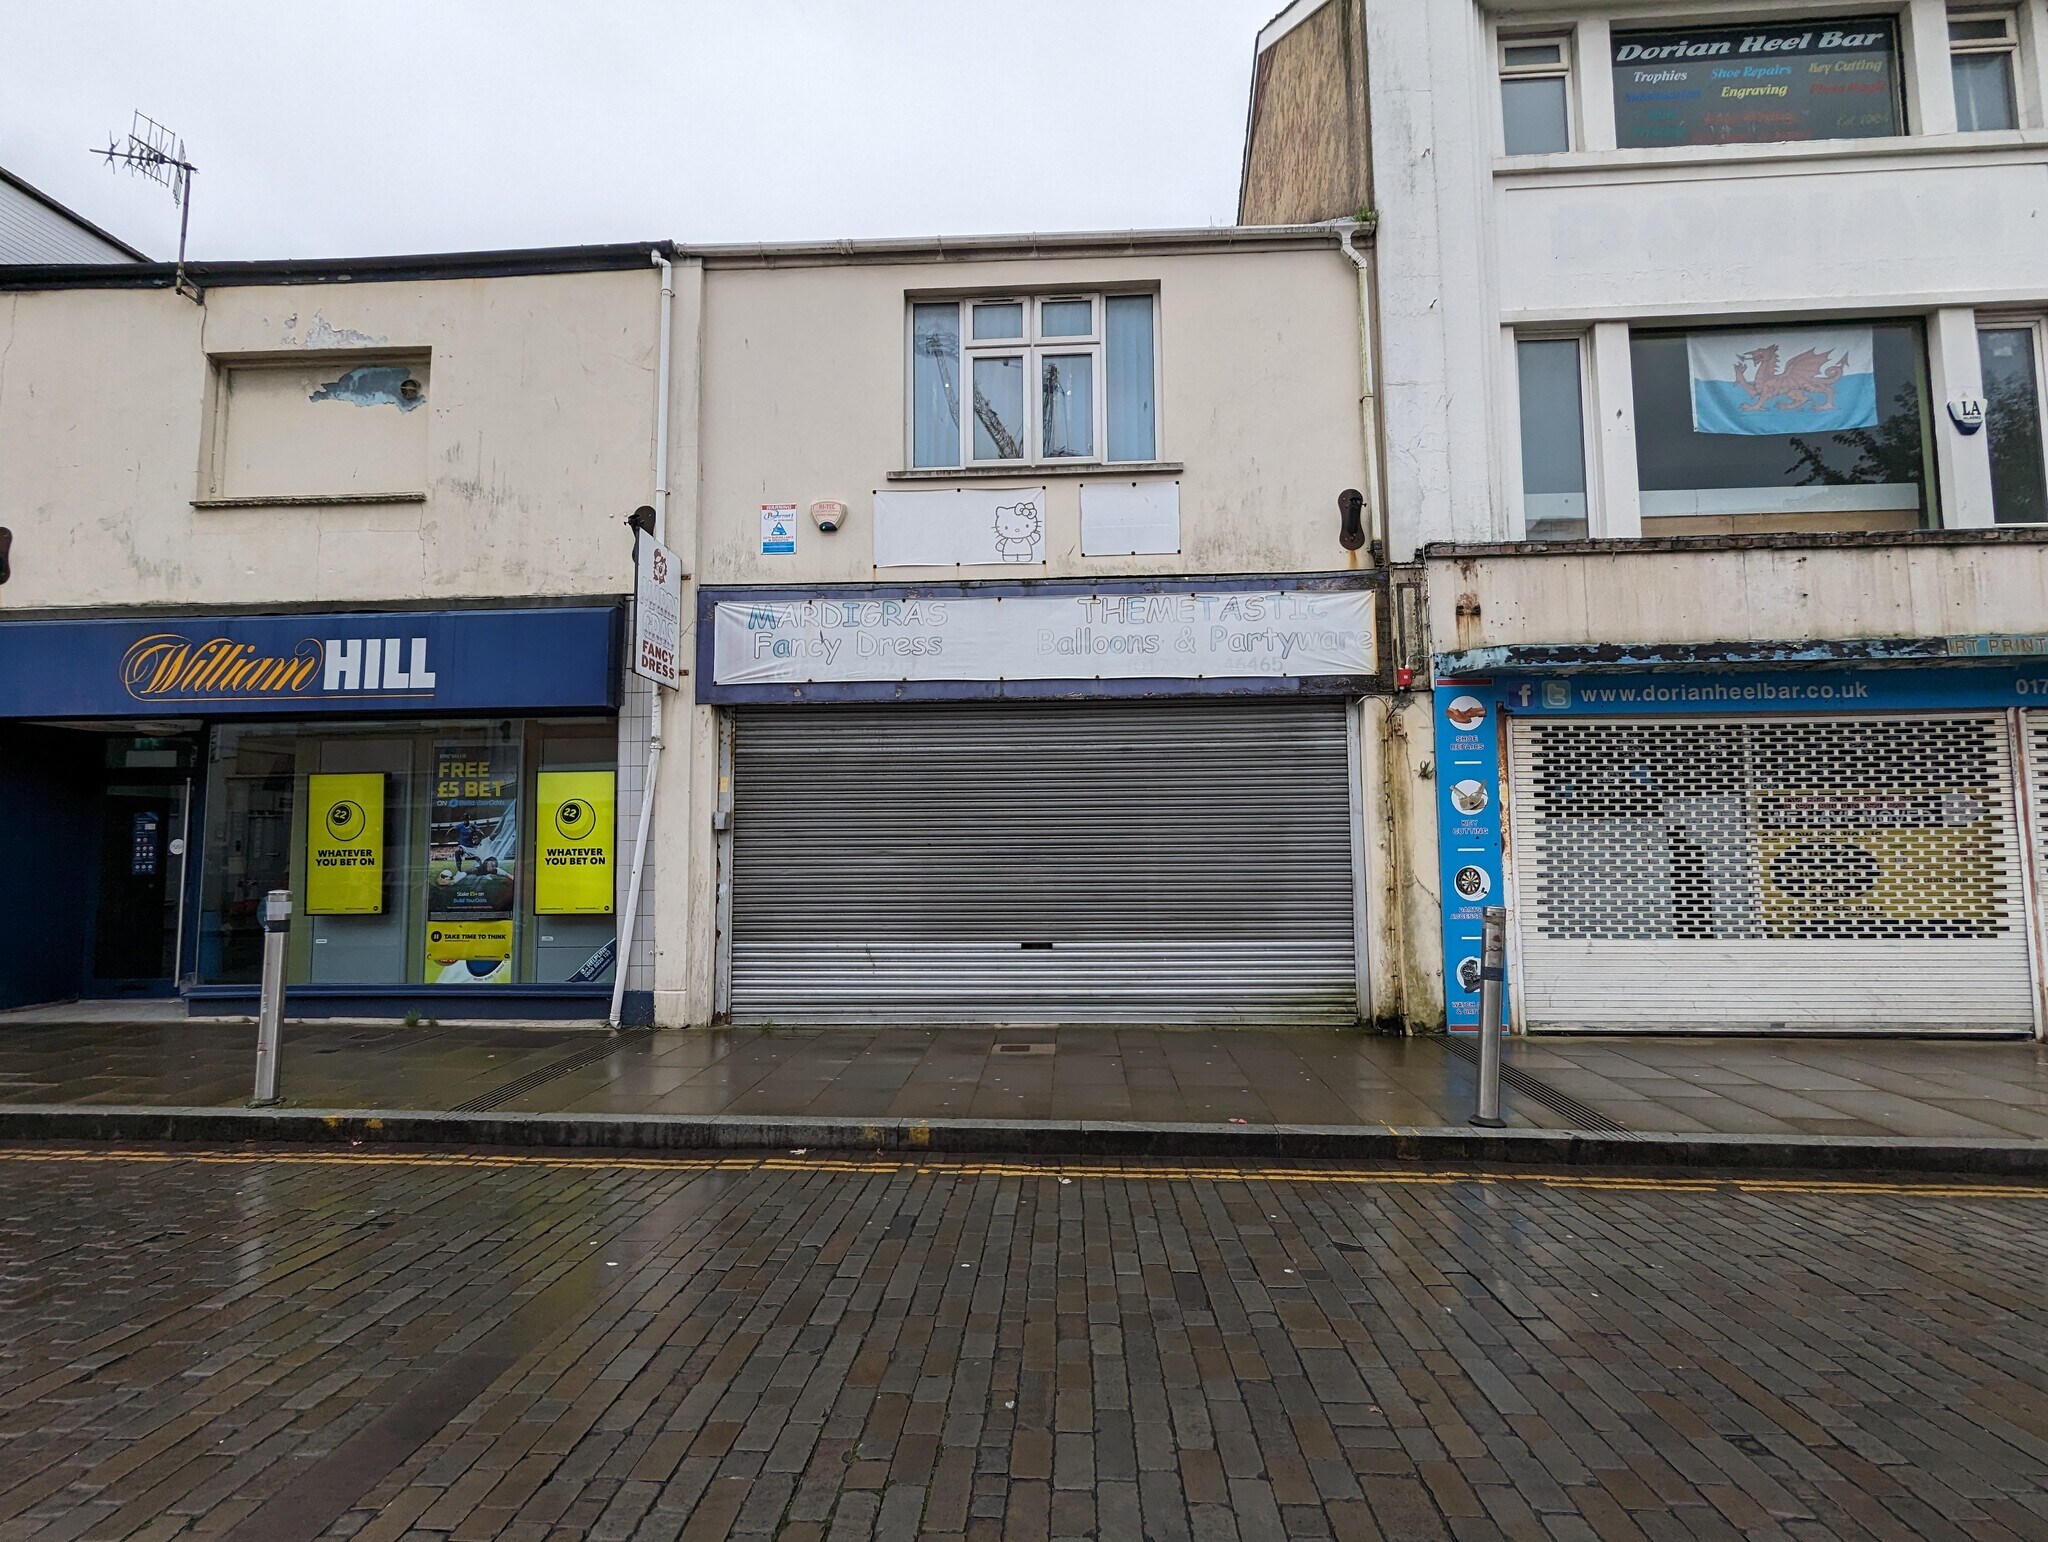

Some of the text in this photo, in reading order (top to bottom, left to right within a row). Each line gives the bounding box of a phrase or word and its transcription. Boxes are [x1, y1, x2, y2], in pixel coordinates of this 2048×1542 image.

[1616, 30, 1884, 62] Dorian Heel Bar
[1710, 64, 1793, 80] Shoe Repairs
[1834, 58, 1885, 74] Cutting
[1633, 69, 1688, 84] Trophies
[1720, 83, 1790, 100] Engraving
[1961, 400, 1982, 416] LA
[748, 600, 949, 630] MARDIGRAS
[1077, 595, 1328, 625] THEMETASTIC
[753, 629, 943, 666] Fancy Dress
[1036, 624, 1374, 660] Balloons & Partyware
[1988, 638, 2046, 653] PRINT
[642, 639, 675, 666] FANCY
[119, 633, 436, 692] William HILL
[641, 654, 675, 680] DRESS
[1580, 681, 1869, 702] www.dorianheelbar.co.uk
[1455, 735, 1479, 743] SHOE
[438, 761, 490, 778] FREE
[437, 779, 506, 798] £5 BET
[333, 809, 348, 819] 22
[563, 807, 577, 818] 22
[1452, 827, 1489, 835] CUTTING
[317, 849, 373, 857] WHATEVER
[546, 848, 603, 857] WHATEVER
[316, 857, 375, 866] YOU BET ON
[545, 856, 606, 866] YOU BET ON
